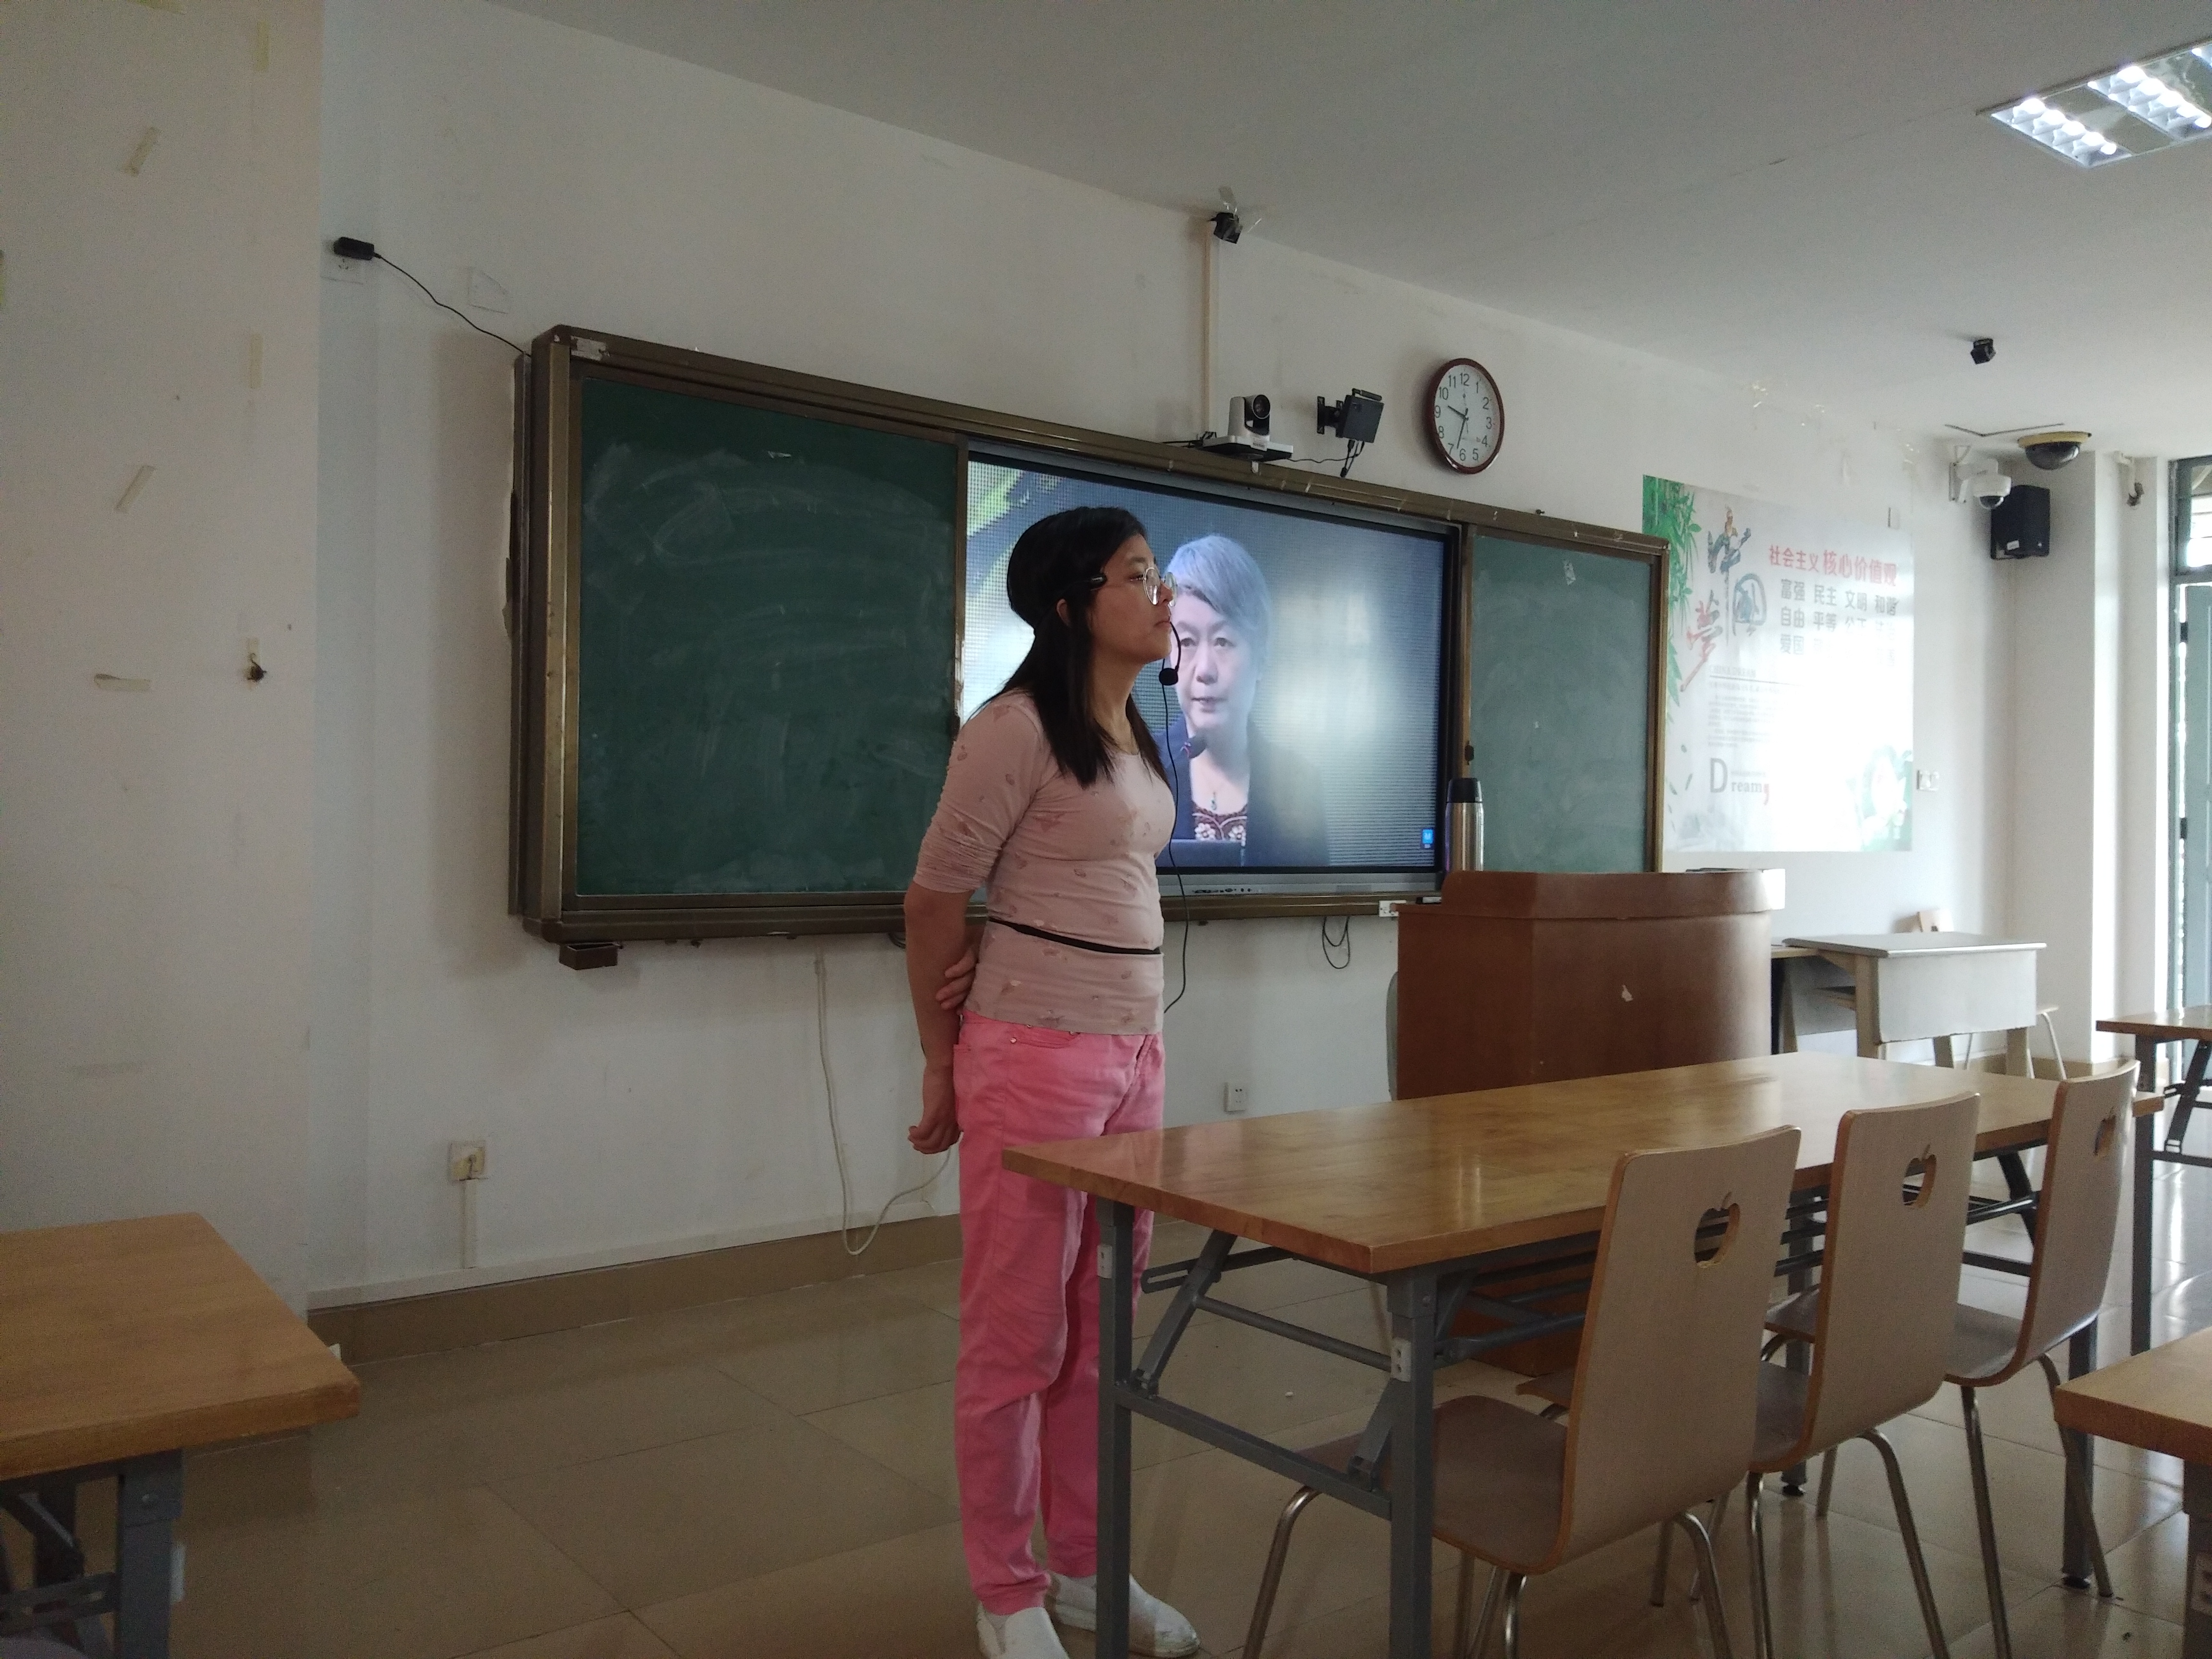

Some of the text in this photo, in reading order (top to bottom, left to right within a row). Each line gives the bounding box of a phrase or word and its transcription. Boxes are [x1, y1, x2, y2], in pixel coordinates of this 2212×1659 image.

[1448, 375, 1456, 388] 11
[1460, 373, 1470, 386] 12
[1439, 387, 1449, 400] 10
[1482, 397, 1490, 410] 2
[1434, 406, 1441, 418] 9
[1486, 417, 1492, 430] 3
[1438, 426, 1444, 439] 8
[1481, 435, 1488, 447] 4
[1447, 443, 1455, 455] 7
[1459, 448, 1467, 461] 6
[1472, 448, 1479, 460] 5
